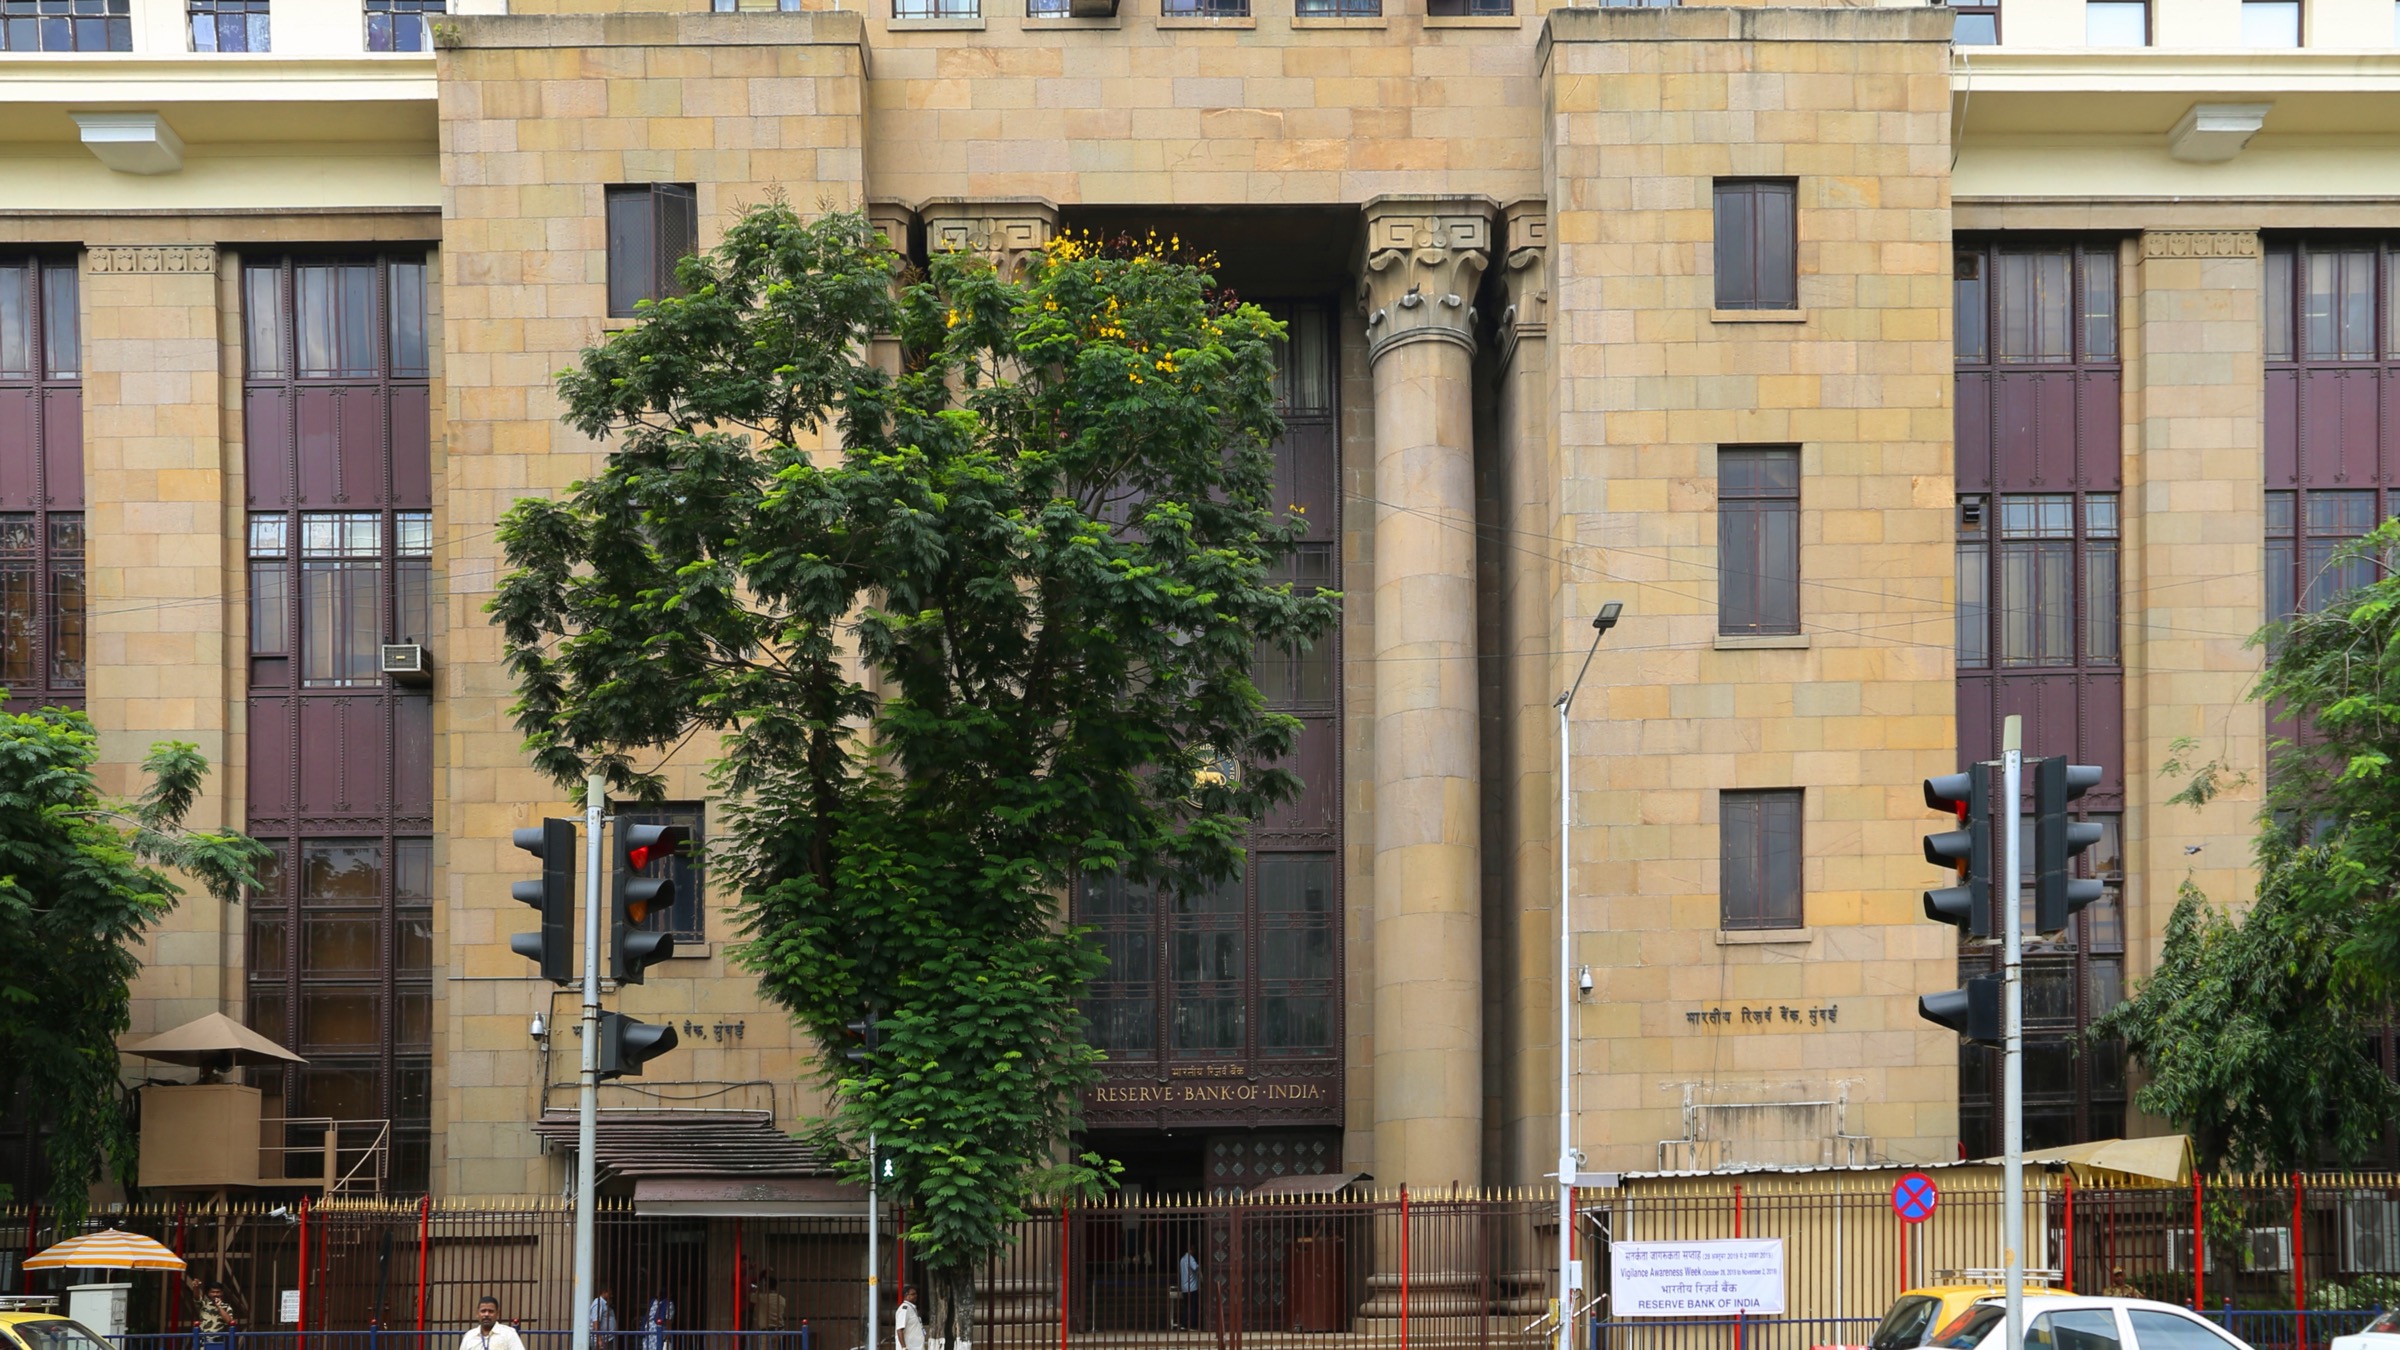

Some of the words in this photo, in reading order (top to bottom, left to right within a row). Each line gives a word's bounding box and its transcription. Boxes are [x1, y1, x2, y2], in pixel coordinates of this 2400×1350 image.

[1686, 1008, 1731, 1024] भारतीय
[1809, 1005, 1837, 1026] मुंबई
[713, 1020, 745, 1042] मुंबई
[1172, 1065, 1203, 1078] भारतीय
[1230, 1063, 1244, 1076] बैंक
[1096, 1086, 1174, 1102] RESERVE
[1184, 1085, 1232, 1101] BANK
[1237, 1084, 1259, 1100] OF
[1269, 1084, 1319, 1100] INDIA
[1625, 1248, 1648, 1261] सतर्कता
[1682, 1250, 1701, 1262] सप्ताह
[1621, 1268, 1648, 1280] Vigilance
[1650, 1268, 1683, 1278] Awareness
[1684, 1267, 1701, 1277] Week
[1661, 1282, 1692, 1294] भारतीय
[1721, 1279, 1738, 1293] बैंक
[1638, 1300, 1685, 1309] RESERVE
[1687, 1299, 1715, 1309] BANK
[1718, 1299, 1731, 1308] OF
[1734, 1298, 1760, 1308] INDIA
